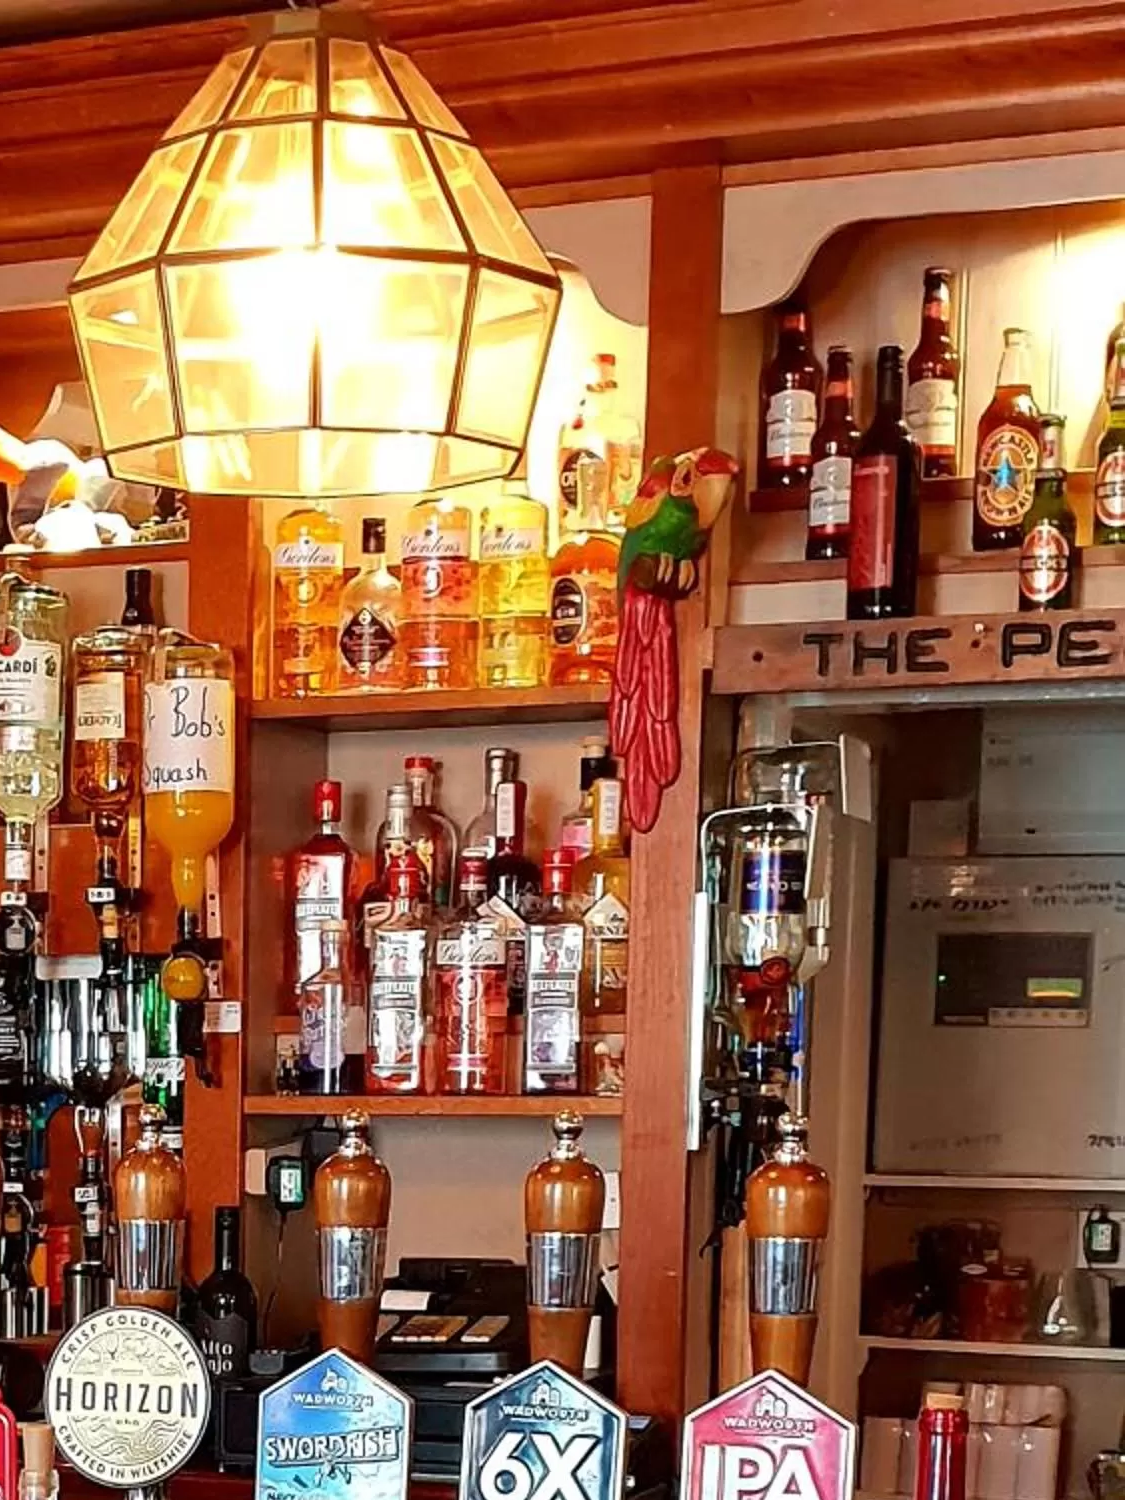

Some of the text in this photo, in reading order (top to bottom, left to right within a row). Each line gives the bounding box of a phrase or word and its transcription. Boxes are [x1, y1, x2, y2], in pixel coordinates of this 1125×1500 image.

[803, 627, 952, 677] THE
[171, 685, 226, 738] Bob's
[61, 1323, 99, 1364] CRISP
[106, 1314, 172, 1339] GOLDEN
[174, 1341, 197, 1371] ALE
[55, 1376, 199, 1418] HORIZON
[292, 1393, 375, 1408] WADWORTH
[501, 1405, 590, 1421] WADWORTH
[723, 1416, 816, 1432] WADWORTH
[58, 1425, 194, 1480] CRAFTED IN WILTSHIRE
